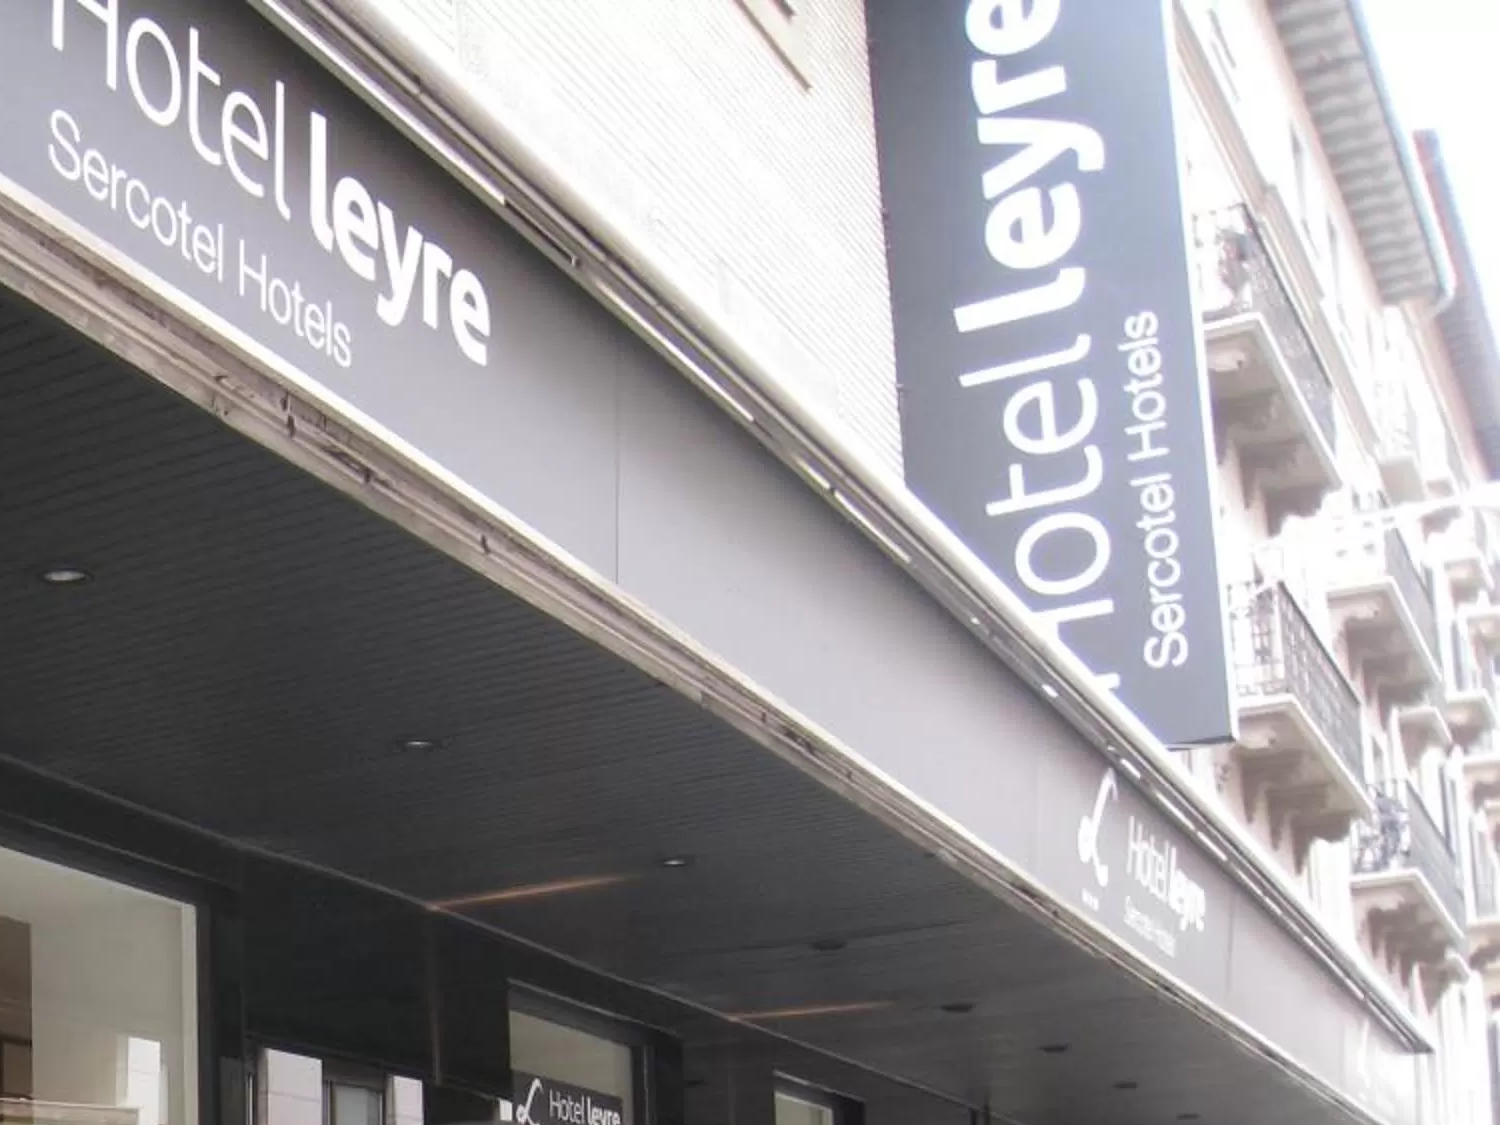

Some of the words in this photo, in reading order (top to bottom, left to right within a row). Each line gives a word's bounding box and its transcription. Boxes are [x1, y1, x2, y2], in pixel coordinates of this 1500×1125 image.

[48, 109, 225, 281] Sercotel
[239, 237, 353, 368] Hotels
[310, 110, 492, 367] leyre
[954, 0, 1105, 333] leyre
[1117, 310, 1171, 462] Hotels
[1129, 472, 1188, 669] Sercotel
[549, 1088, 585, 1125] Hotel
